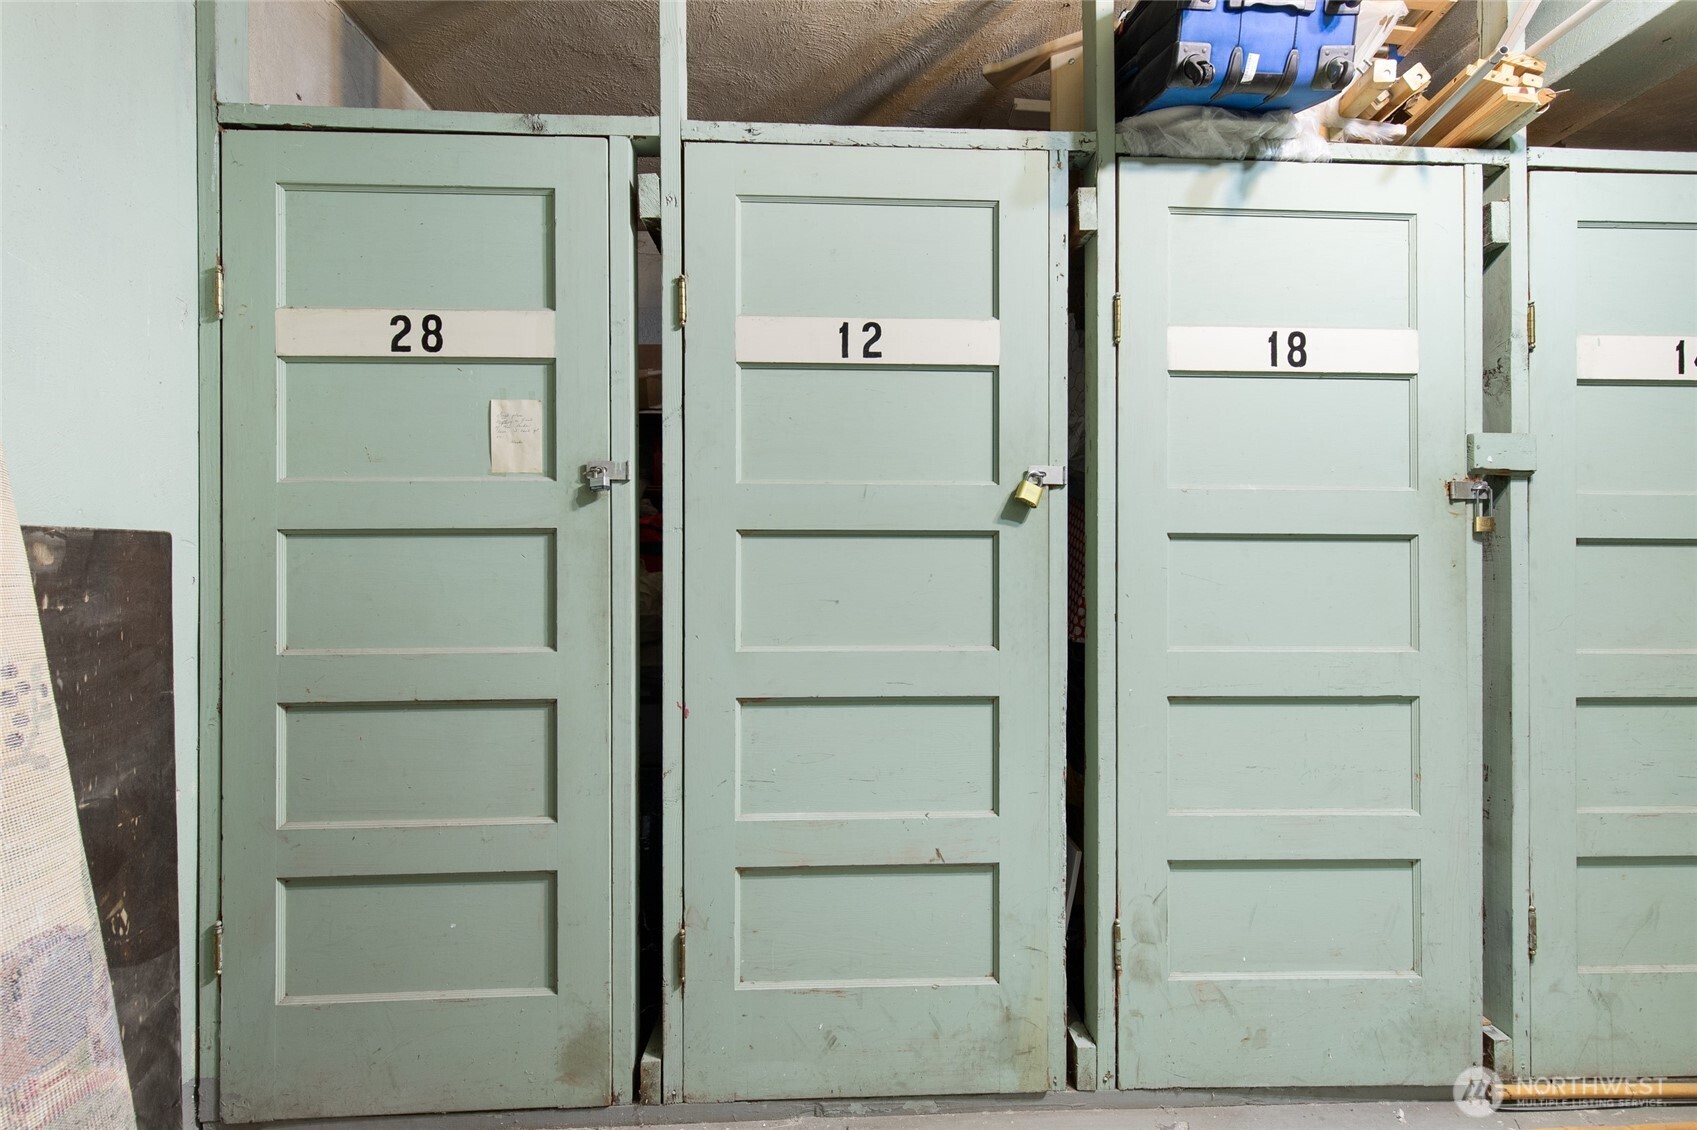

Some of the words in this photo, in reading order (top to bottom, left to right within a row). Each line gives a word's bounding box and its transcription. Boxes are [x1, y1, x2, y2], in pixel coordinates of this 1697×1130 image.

[389, 313, 444, 353] 28
[839, 321, 883, 359] 12
[1268, 330, 1307, 368] 18
[1675, 339, 1697, 375] 1
